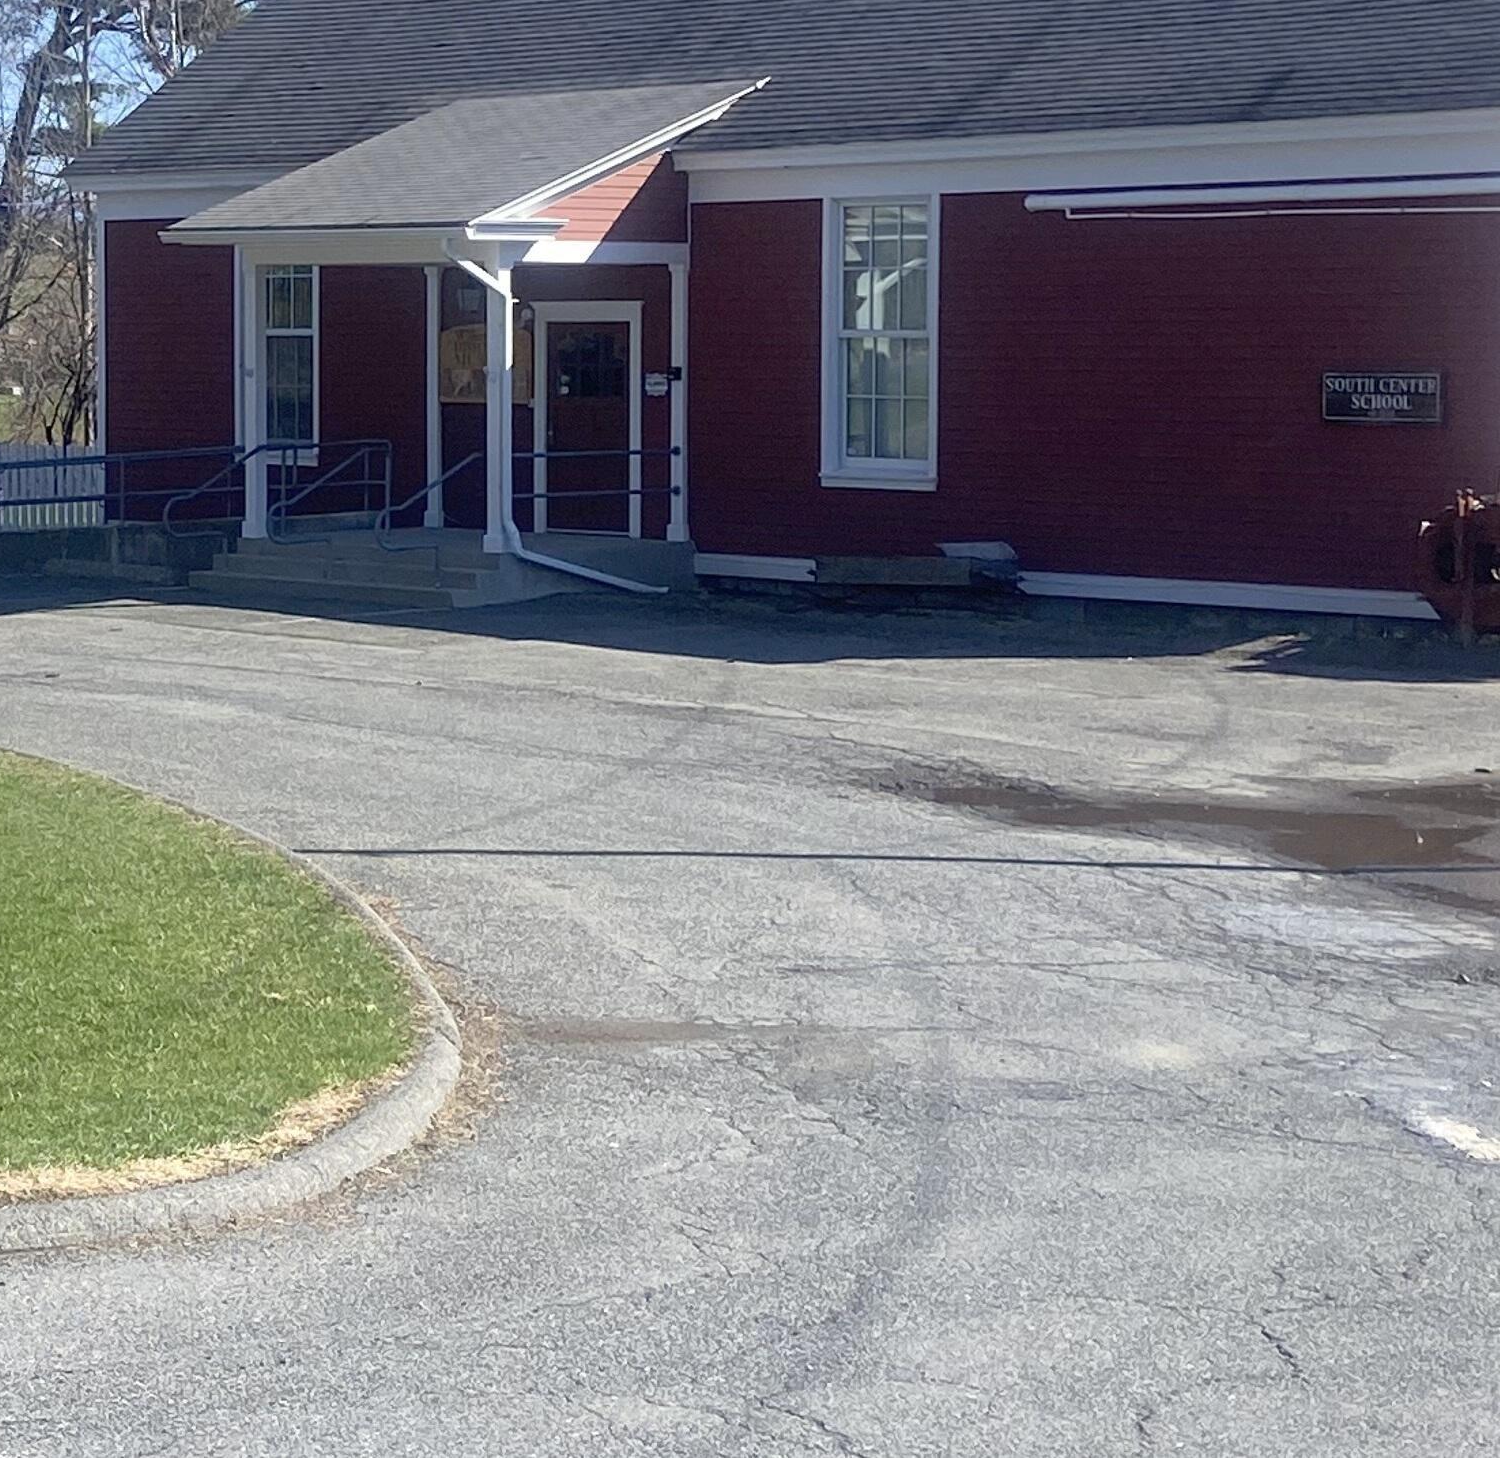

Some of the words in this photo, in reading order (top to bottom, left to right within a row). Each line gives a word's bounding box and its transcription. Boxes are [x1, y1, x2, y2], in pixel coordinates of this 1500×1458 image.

[1325, 377, 1375, 393] SOUTH
[1379, 378, 1437, 394] CENTER
[1351, 394, 1412, 410] SCHOOL
